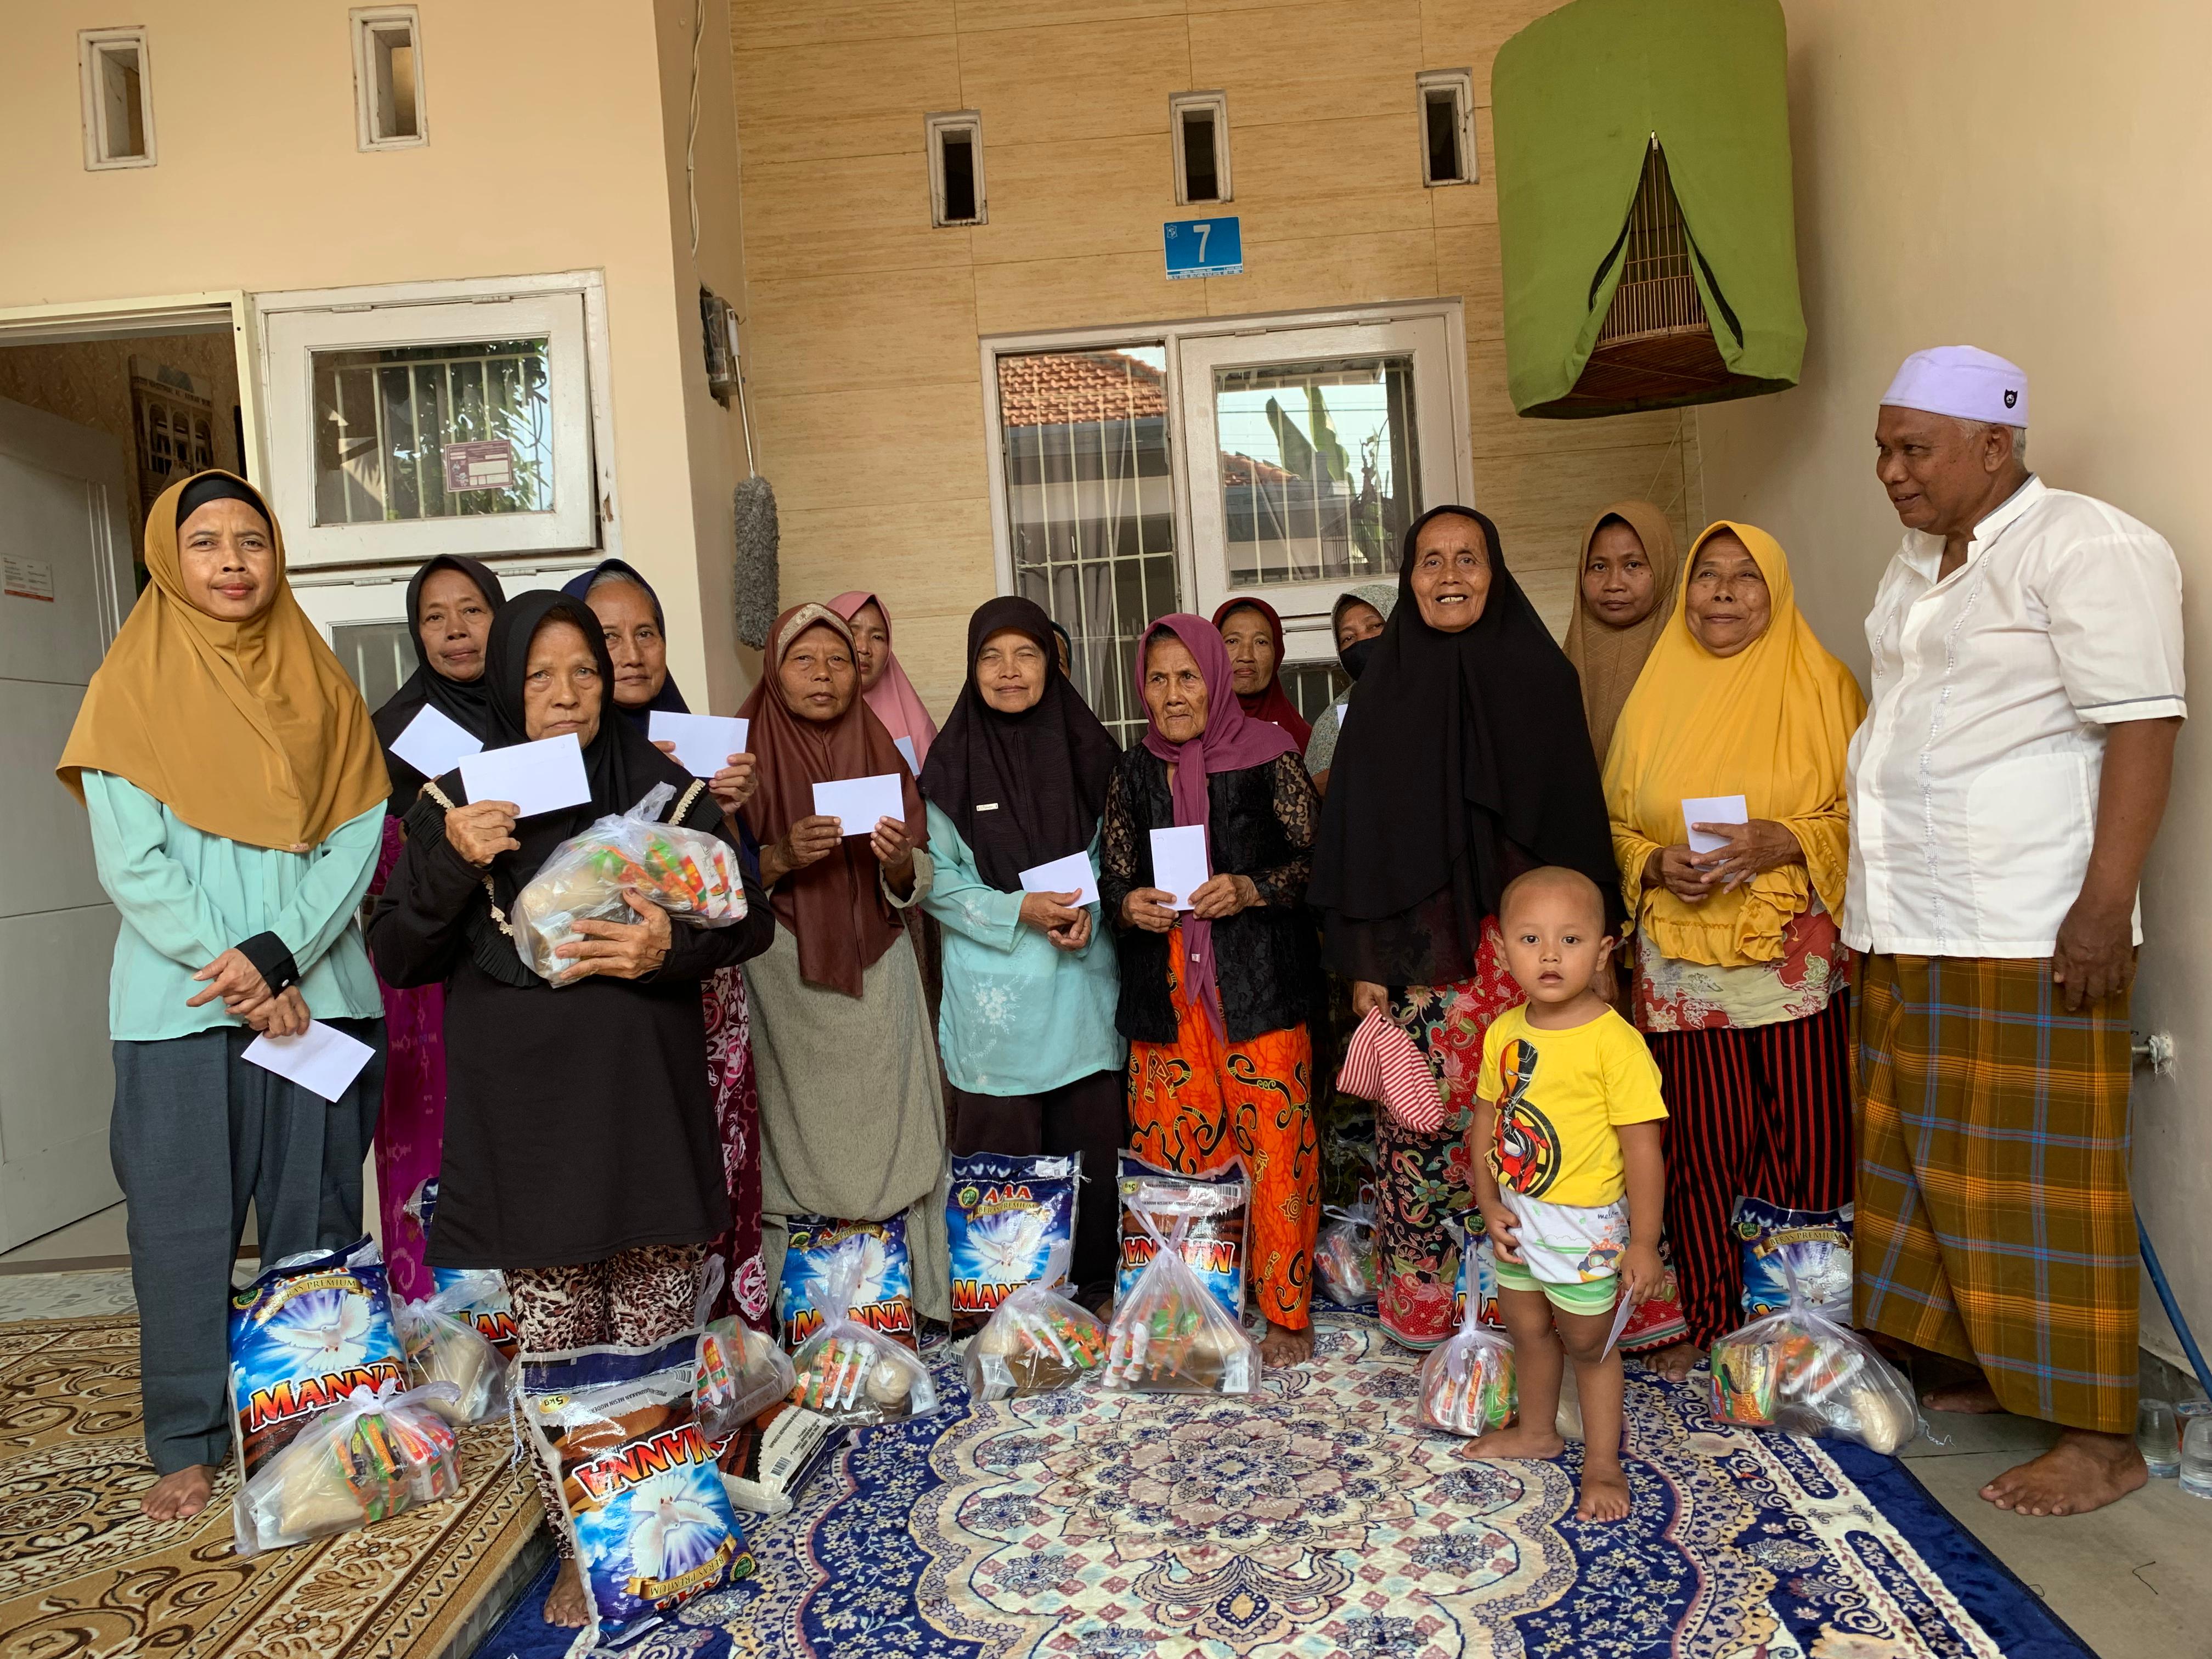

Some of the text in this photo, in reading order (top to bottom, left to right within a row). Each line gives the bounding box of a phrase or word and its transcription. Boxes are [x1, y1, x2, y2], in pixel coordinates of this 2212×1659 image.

[1193, 224, 1211, 263] 7
[984, 1185, 1032, 1203] AAA
[1770, 1231, 1843, 1246] BERAS PREMIUM
[1125, 1238, 1233, 1273] MANA
[307, 1279, 356, 1290] PREMIUM
[795, 1302, 910, 1341] MNNA
[544, 1396, 563, 1406] 5kg
[610, 1397, 624, 1406] MESIN
[576, 1423, 715, 1497] MANNA
[651, 1555, 724, 1596] BERAS PREMIUM
